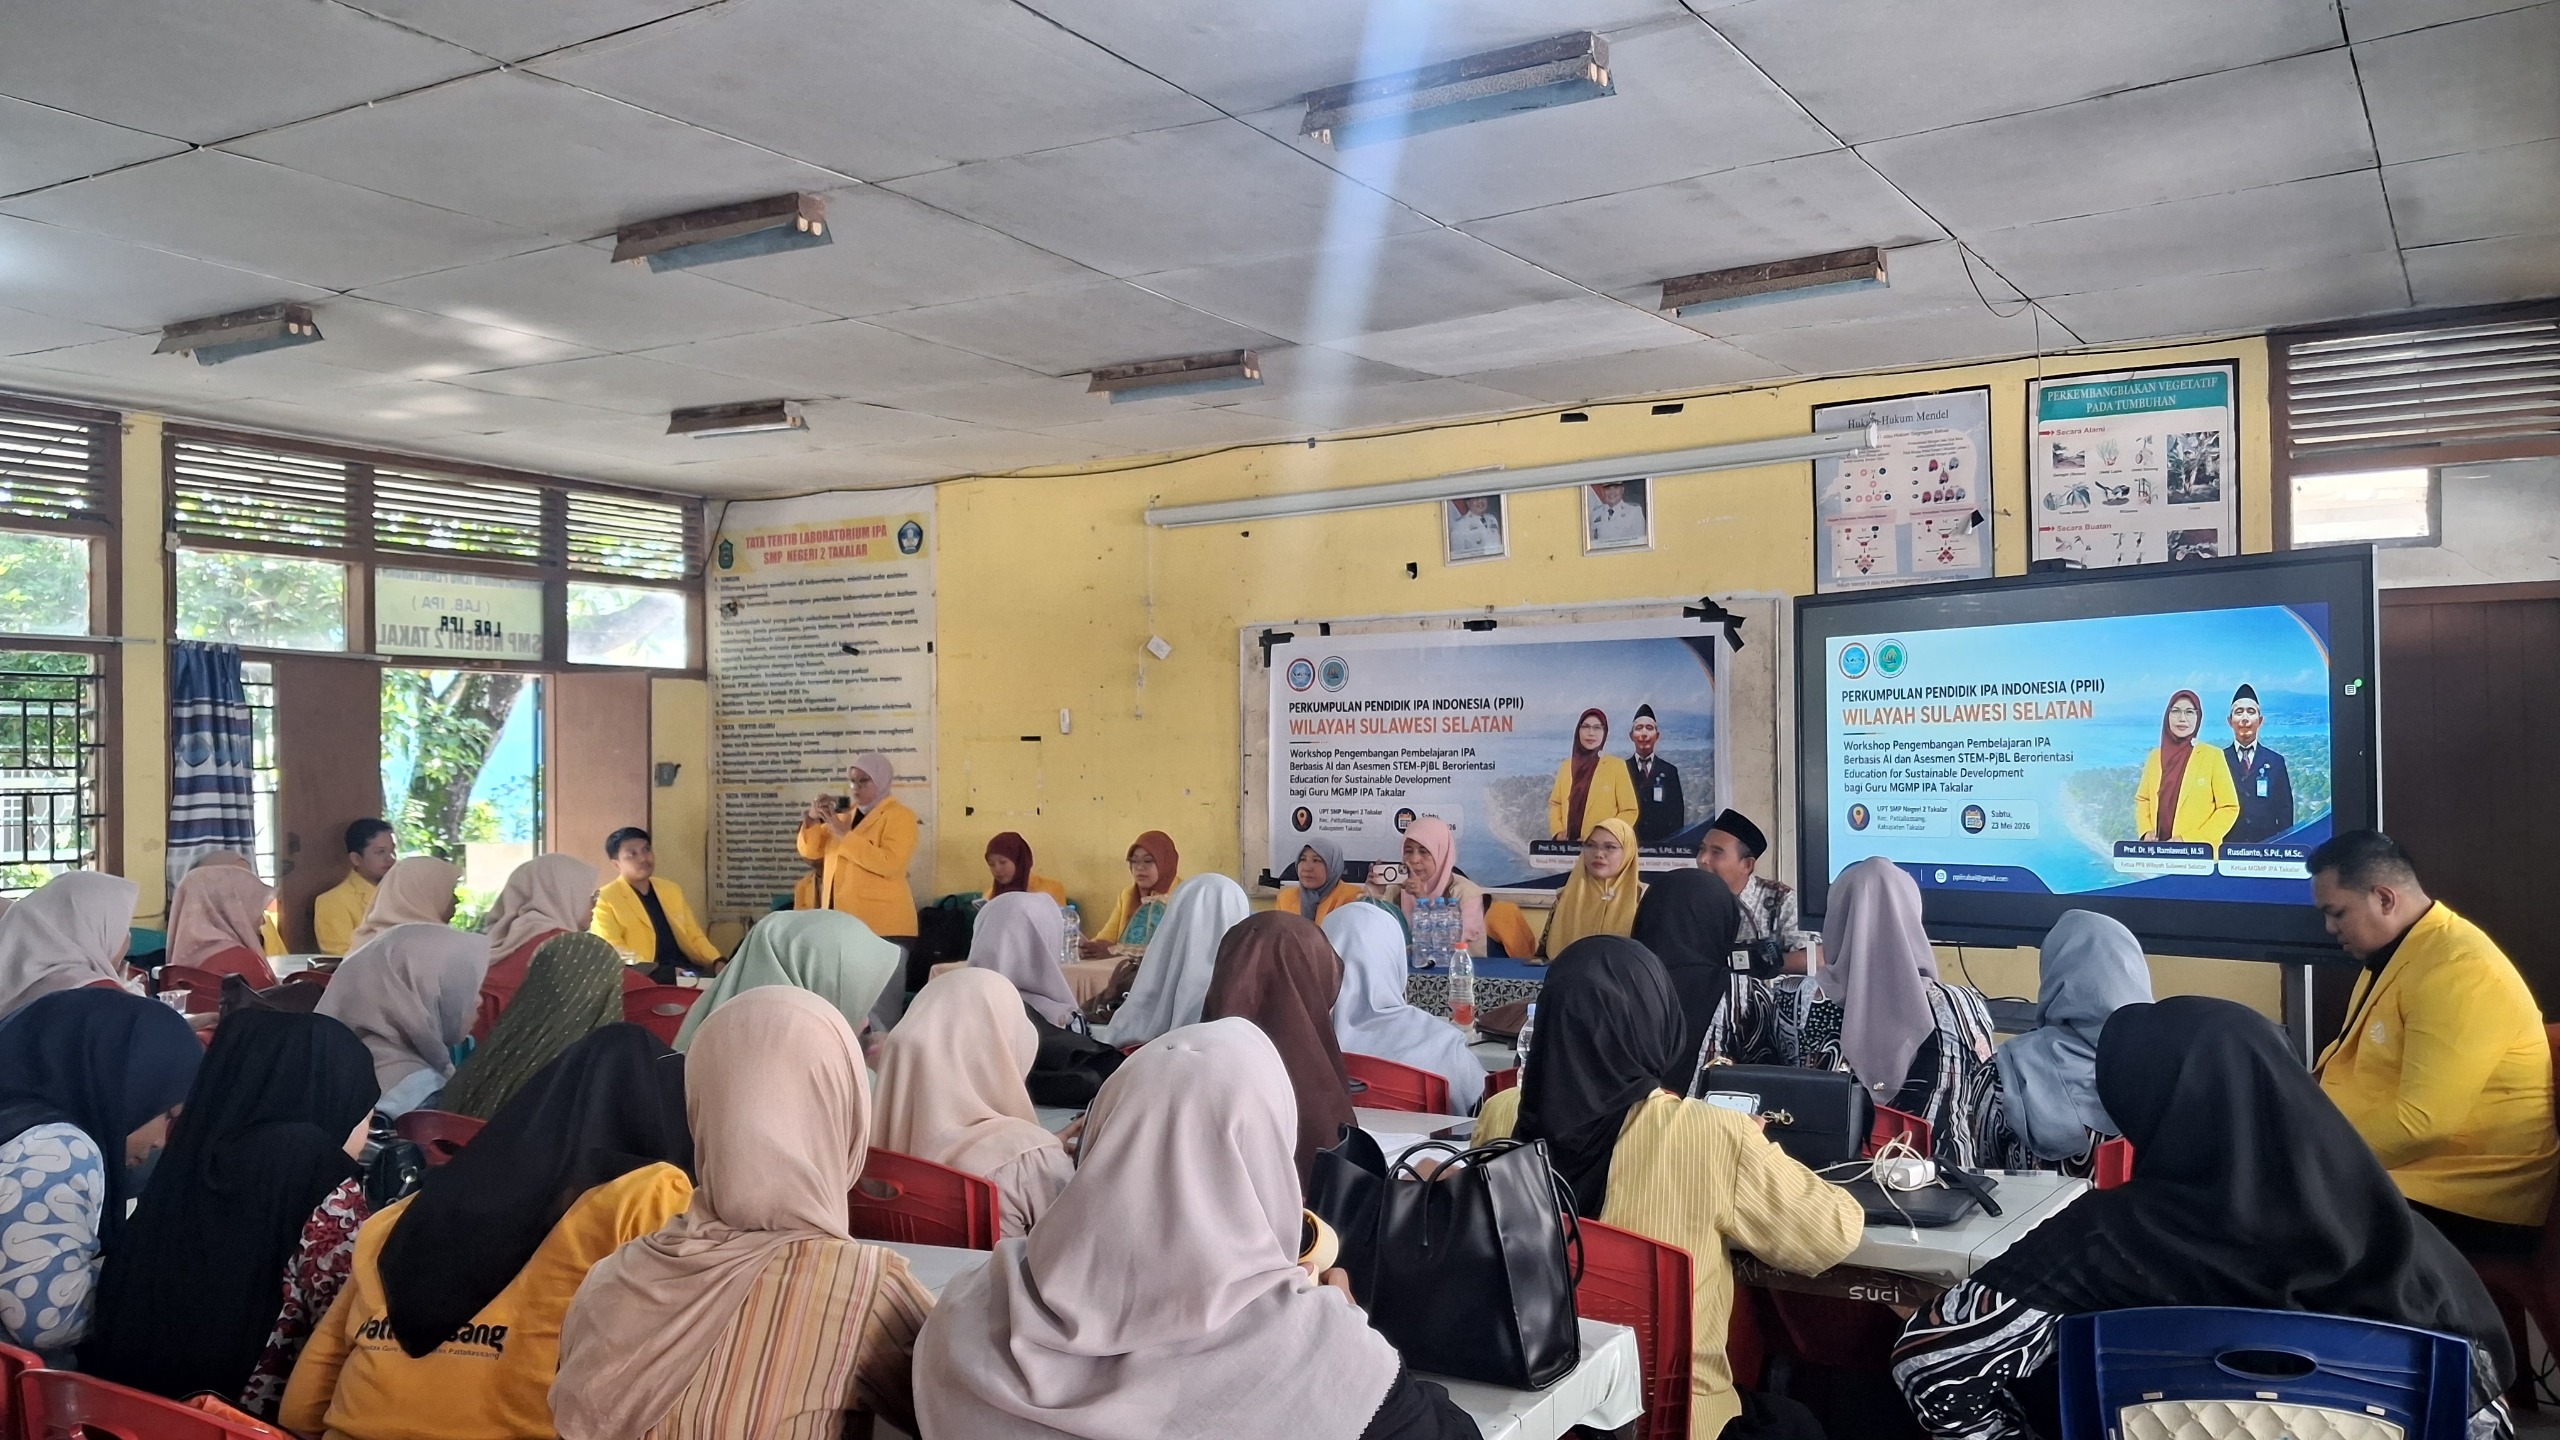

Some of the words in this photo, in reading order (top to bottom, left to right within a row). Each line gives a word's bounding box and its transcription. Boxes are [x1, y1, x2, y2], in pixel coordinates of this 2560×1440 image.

[2047, 380, 2156, 402] PERKEMBANGBIAKAN
[2159, 376, 2219, 391] VEGETATIF
[2086, 401, 2115, 413] PADA
[2116, 395, 2177, 411] TUMBUHAN
[1916, 409, 1949, 421] Mendel
[2056, 428, 2082, 436] Secara
[2084, 523, 2112, 531] Buatan
[745, 535, 765, 549] TATA
[767, 532, 798, 547] TERTIB
[799, 526, 870, 545] LABORATORIUM
[872, 524, 888, 538] IPA
[763, 551, 782, 565] SMP
[787, 548, 818, 562] NEGERI
[820, 547, 826, 560] 2
[828, 544, 868, 559] TAKALAR
[1842, 688, 1923, 702] PERKUMPULAN
[1925, 685, 1977, 699] PENDIDIK
[1980, 683, 1999, 697] IPA
[2001, 681, 2067, 696] INDONESIA
[2070, 678, 2105, 695] (PPII)
[1289, 701, 1362, 714] PERKUMPULAN
[1364, 699, 1411, 712] PENDIDIK
[1413, 699, 1430, 710] IPA
[1432, 697, 1490, 710] INDONESIA
[1494, 696, 1524, 711] (PPII)
[1842, 706, 1916, 726] WILAYAH
[1921, 703, 2007, 724] SULAWESI
[2012, 700, 2093, 721] SELATAN
[1289, 718, 1356, 735] WILAYAH
[1360, 716, 1437, 734] SULAWESI
[1442, 715, 1513, 733] SELATAN
[1843, 740, 1891, 752] Workshop
[1893, 738, 1965, 752] Pengembangan
[1967, 737, 2032, 750] Pembelajaran
[2034, 736, 2051, 748] IPA
[1290, 749, 1333, 761] Workshop
[1334, 749, 1399, 761] Pengembangan
[1401, 747, 1459, 760] Pembelajaran
[1461, 748, 1476, 758] IPA
[1844, 754, 1881, 765] Berbasis
[1883, 754, 1893, 764] AI
[1894, 753, 1911, 764] dan
[1913, 753, 1956, 764] Asesmen
[1958, 752, 2011, 766] STEM-PjBL
[2013, 751, 2074, 763] Berorientasi
[1289, 761, 1324, 771] Berbasis
[1325, 761, 1334, 771] AI
[1336, 760, 1351, 771] dan
[1353, 760, 1391, 771] Asesmen
[1393, 760, 1440, 773] STEM-PjBL
[1442, 759, 1496, 771] Berorientasi
[1844, 768, 1887, 779] Education
[1889, 768, 1903, 778] for
[1905, 767, 1959, 778] Sustainable
[1960, 766, 2024, 780] Development
[1289, 774, 1329, 784] Education
[1331, 774, 1343, 784] for
[1344, 773, 1393, 784] Sustainable
[1394, 773, 1451, 786] Development
[1289, 786, 1307, 798] bagi
[1308, 787, 1329, 797] Guru
[1331, 787, 1358, 797] MGMP
[1360, 787, 1374, 797] IPA
[1376, 787, 1406, 797] Takalar
[1844, 782, 1863, 794] bagi
[1865, 782, 1888, 793] Guru
[1889, 782, 1920, 793] MGMP
[1922, 782, 1937, 792] IPA
[1939, 782, 1973, 793] Takalar
